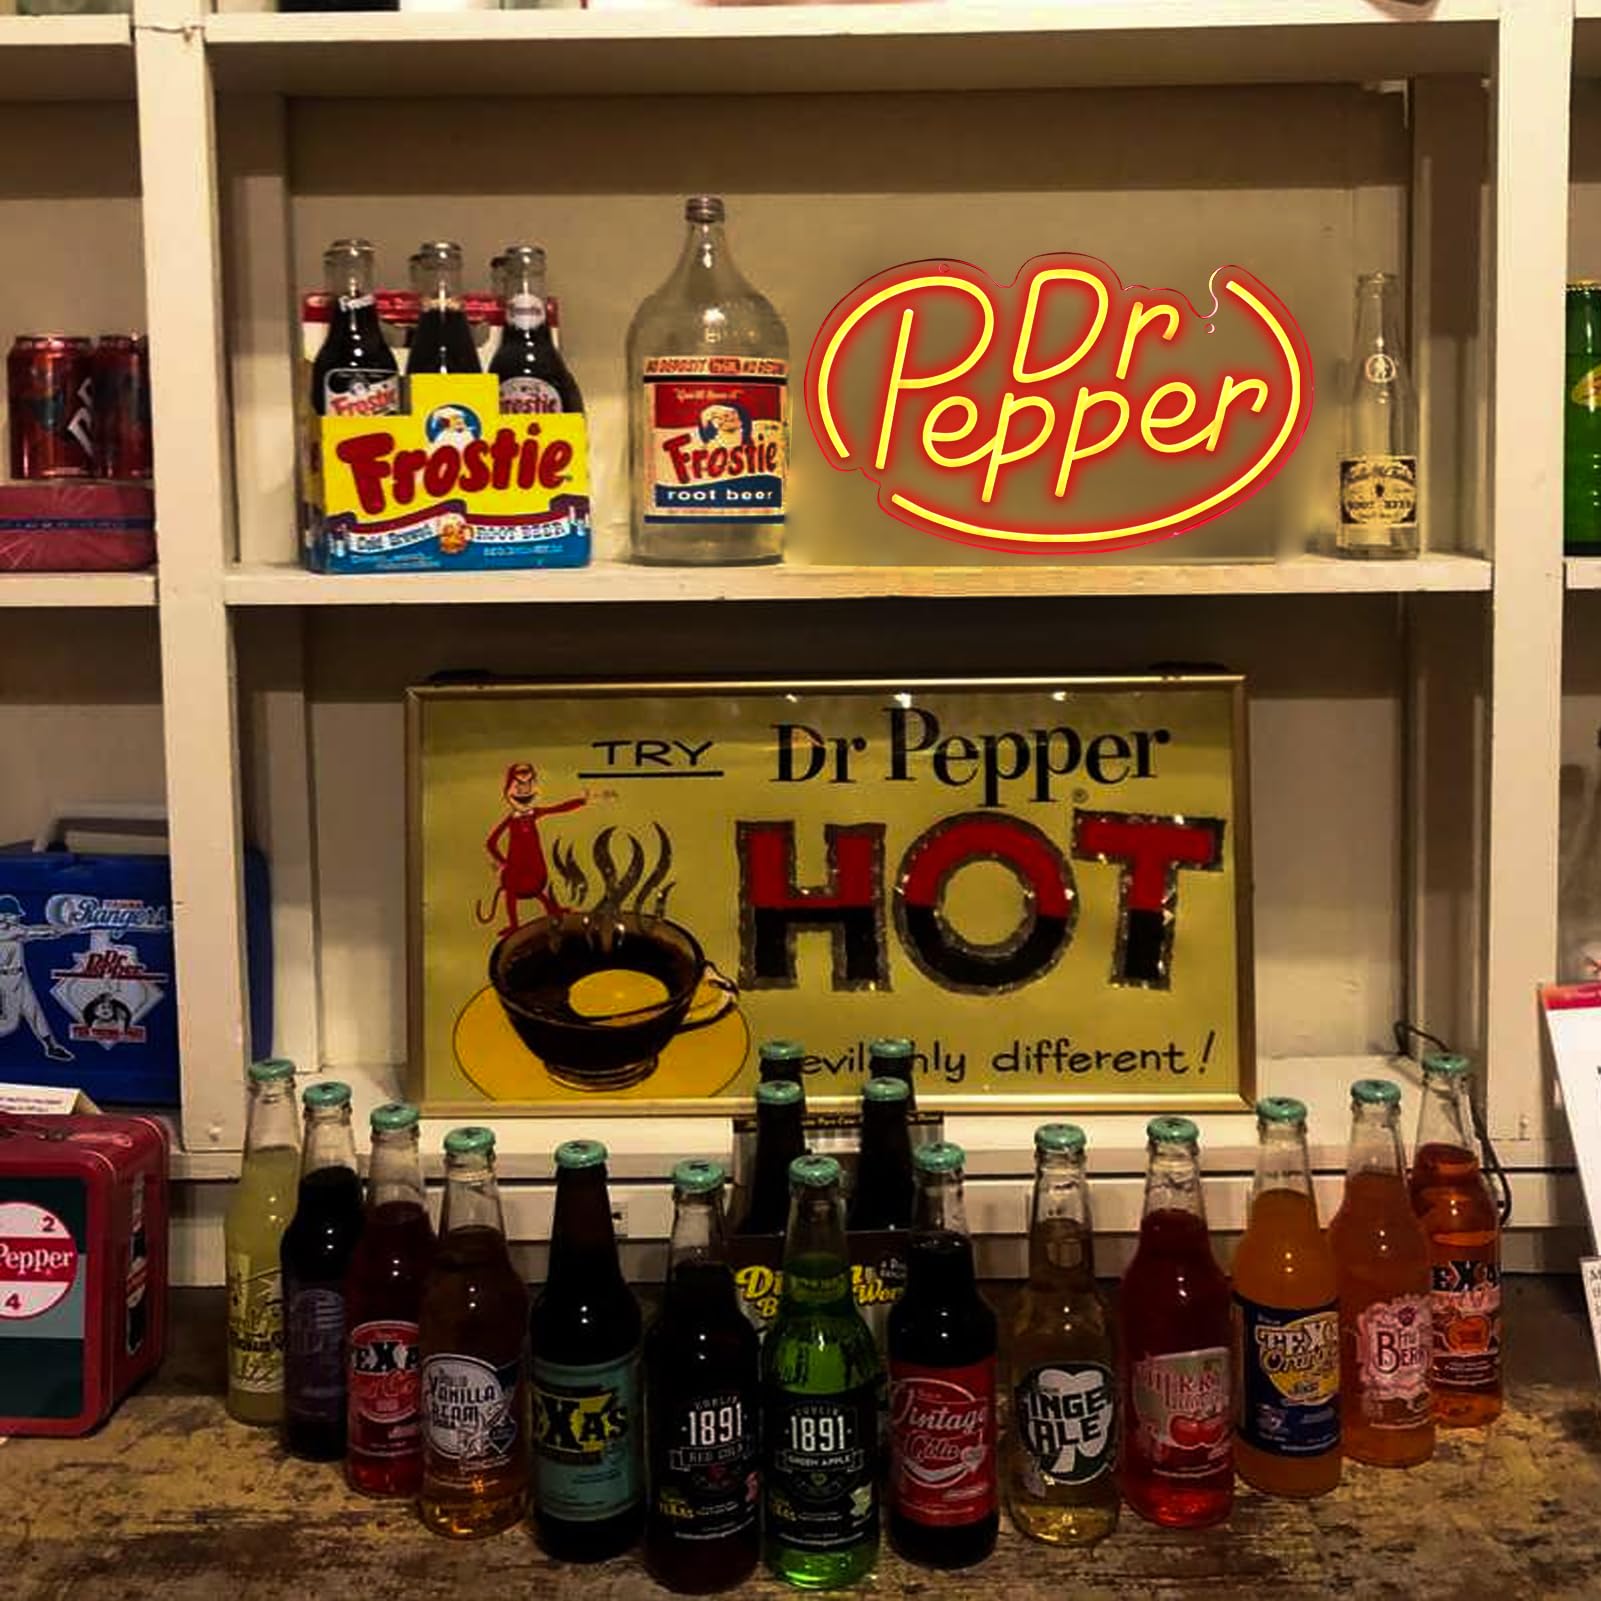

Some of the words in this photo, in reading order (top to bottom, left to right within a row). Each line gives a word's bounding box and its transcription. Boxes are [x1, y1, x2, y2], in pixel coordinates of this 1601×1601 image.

[1012, 268, 1181, 383] Dr
[816, 275, 1269, 503] Pepper
[336, 422, 573, 516] Frostie
[662, 432, 778, 485] Frostie
[667, 489, 717, 501] root
[726, 489, 773, 501] beer
[592, 740, 713, 767] TRY
[770, 723, 867, 783] Dr
[884, 707, 1170, 808] Pepper
[72, 898, 168, 935] Rangers
[735, 809, 1226, 996] HOT
[42, 1215, 56, 1233] 2
[0, 1243, 74, 1275] Pepper
[5, 1292, 22, 1311] 4
[688, 1402, 742, 1446] 1891
[790, 1415, 846, 1452] 1891
[1033, 1414, 1102, 1457] ALE
